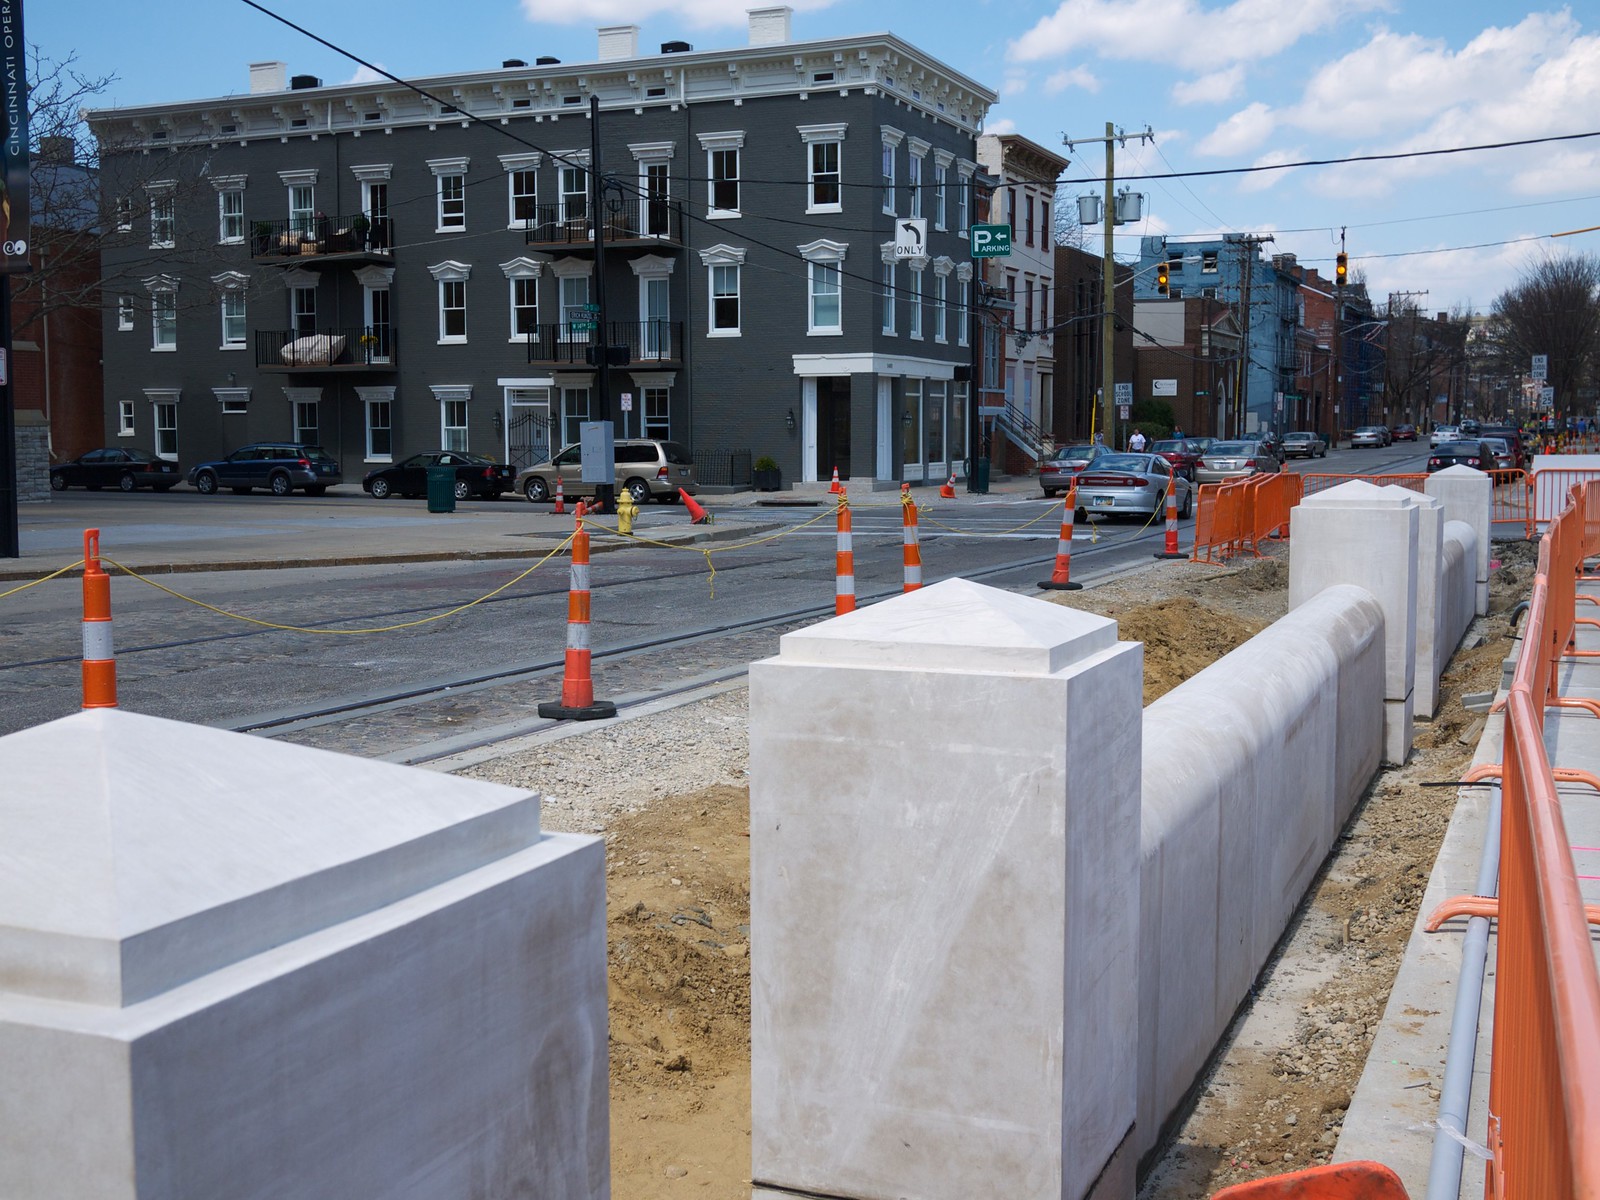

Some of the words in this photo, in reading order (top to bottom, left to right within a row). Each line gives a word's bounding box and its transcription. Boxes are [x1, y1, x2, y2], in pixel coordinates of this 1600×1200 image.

[6, 56, 20, 156] CINCINNATI
[974, 230, 1010, 252] PARKING
[897, 245, 923, 255] ONLY
[1542, 397, 1552, 405] 25
